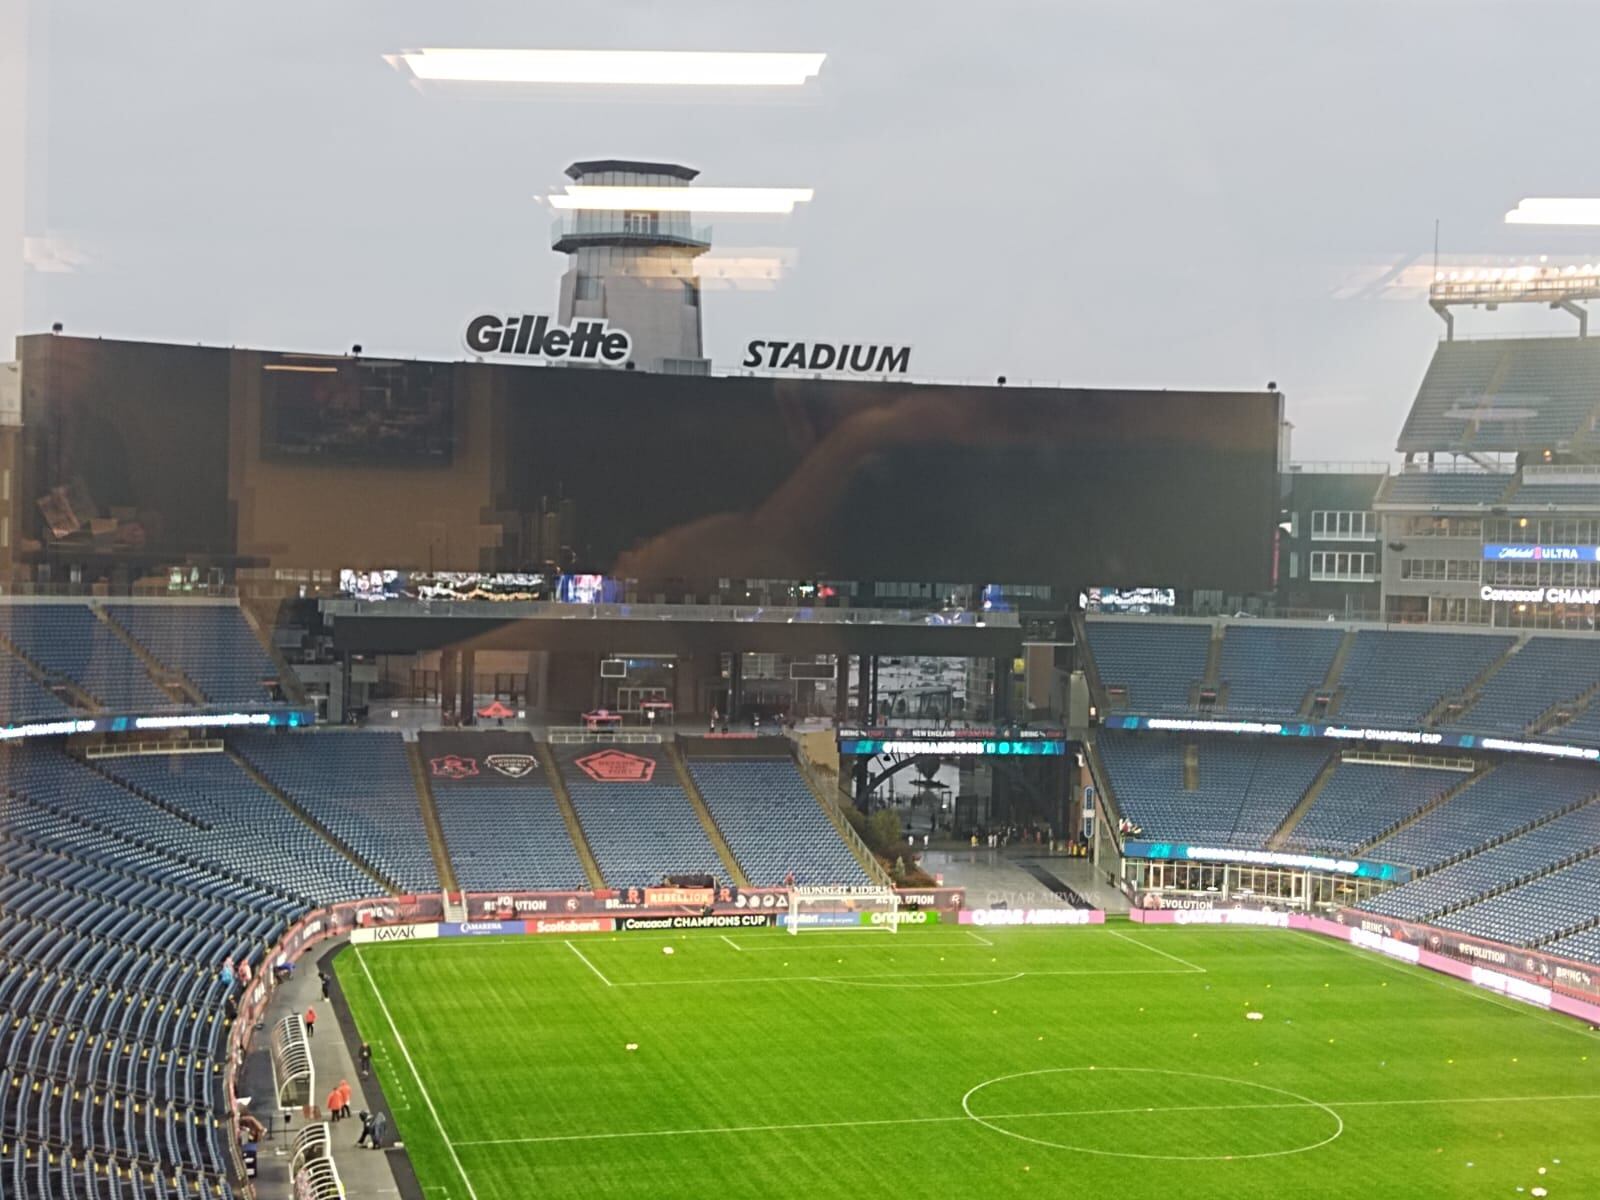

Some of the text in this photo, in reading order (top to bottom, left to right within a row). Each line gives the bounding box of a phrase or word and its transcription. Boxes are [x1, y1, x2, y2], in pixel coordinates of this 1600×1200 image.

[465, 313, 630, 363] Gillette
[743, 339, 911, 374] STADIUM
[1542, 548, 1578, 559] ULTRA
[1481, 586, 1544, 602] Concacaf
[912, 729, 926, 737] NEW
[927, 729, 956, 737] ENGLAND
[1421, 734, 1443, 744] CUP
[850, 885, 888, 896] RIDERS
[650, 893, 709, 903] REBELLION
[1160, 899, 1213, 910] EVOLUTION
[626, 915, 766, 929] Concacaf CHAMPIONS CUP
[871, 911, 927, 924] aramco
[537, 920, 600, 932] Scotiabank
[1361, 920, 1383, 934] BRING
[374, 926, 416, 941] KAVAK
[1459, 943, 1506, 964] REVOLUTION
[1556, 967, 1581, 982] BRING
